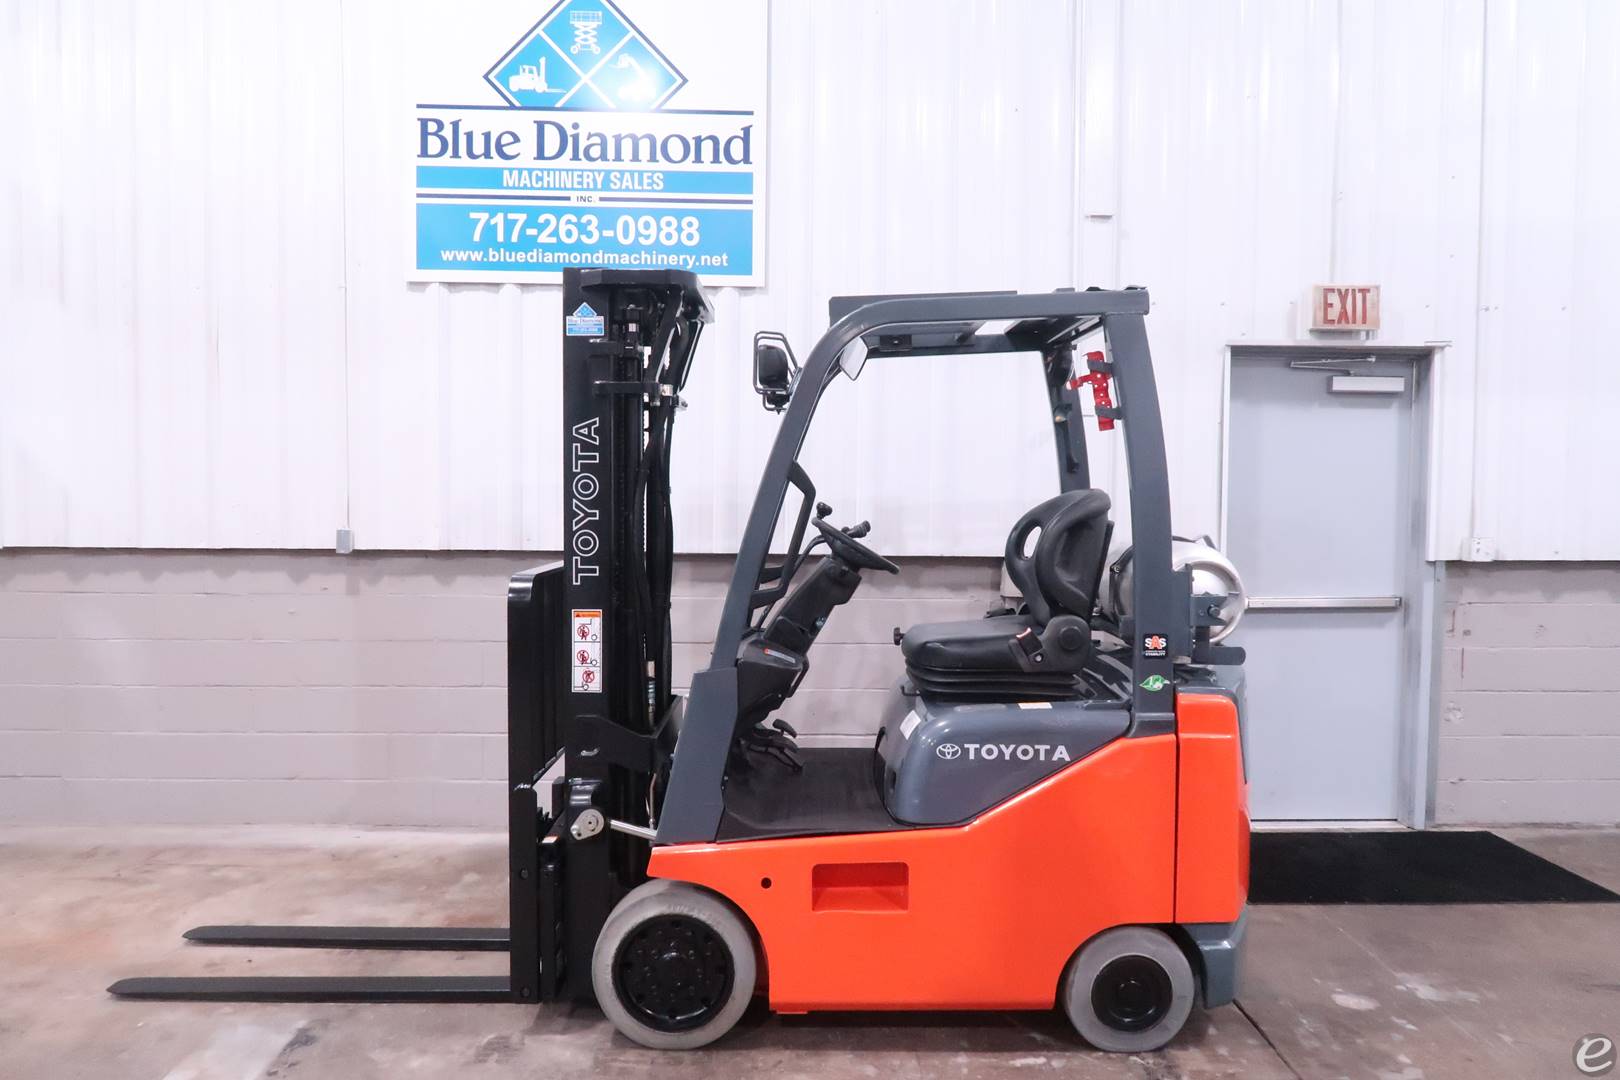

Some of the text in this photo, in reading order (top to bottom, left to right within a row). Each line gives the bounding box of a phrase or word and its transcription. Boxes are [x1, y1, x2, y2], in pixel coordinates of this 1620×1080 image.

[416, 117, 753, 165] Blue Diamond
[503, 169, 664, 190] MACHINERY SALES
[468, 212, 700, 246] 717-263-0988
[440, 248, 728, 267] www.bluediamondmachinery.net
[1323, 288, 1370, 325] EXIT
[572, 416, 600, 586] TOYOTA
[1144, 635, 1167, 650] SAS
[964, 743, 1071, 762] TOYOTA
